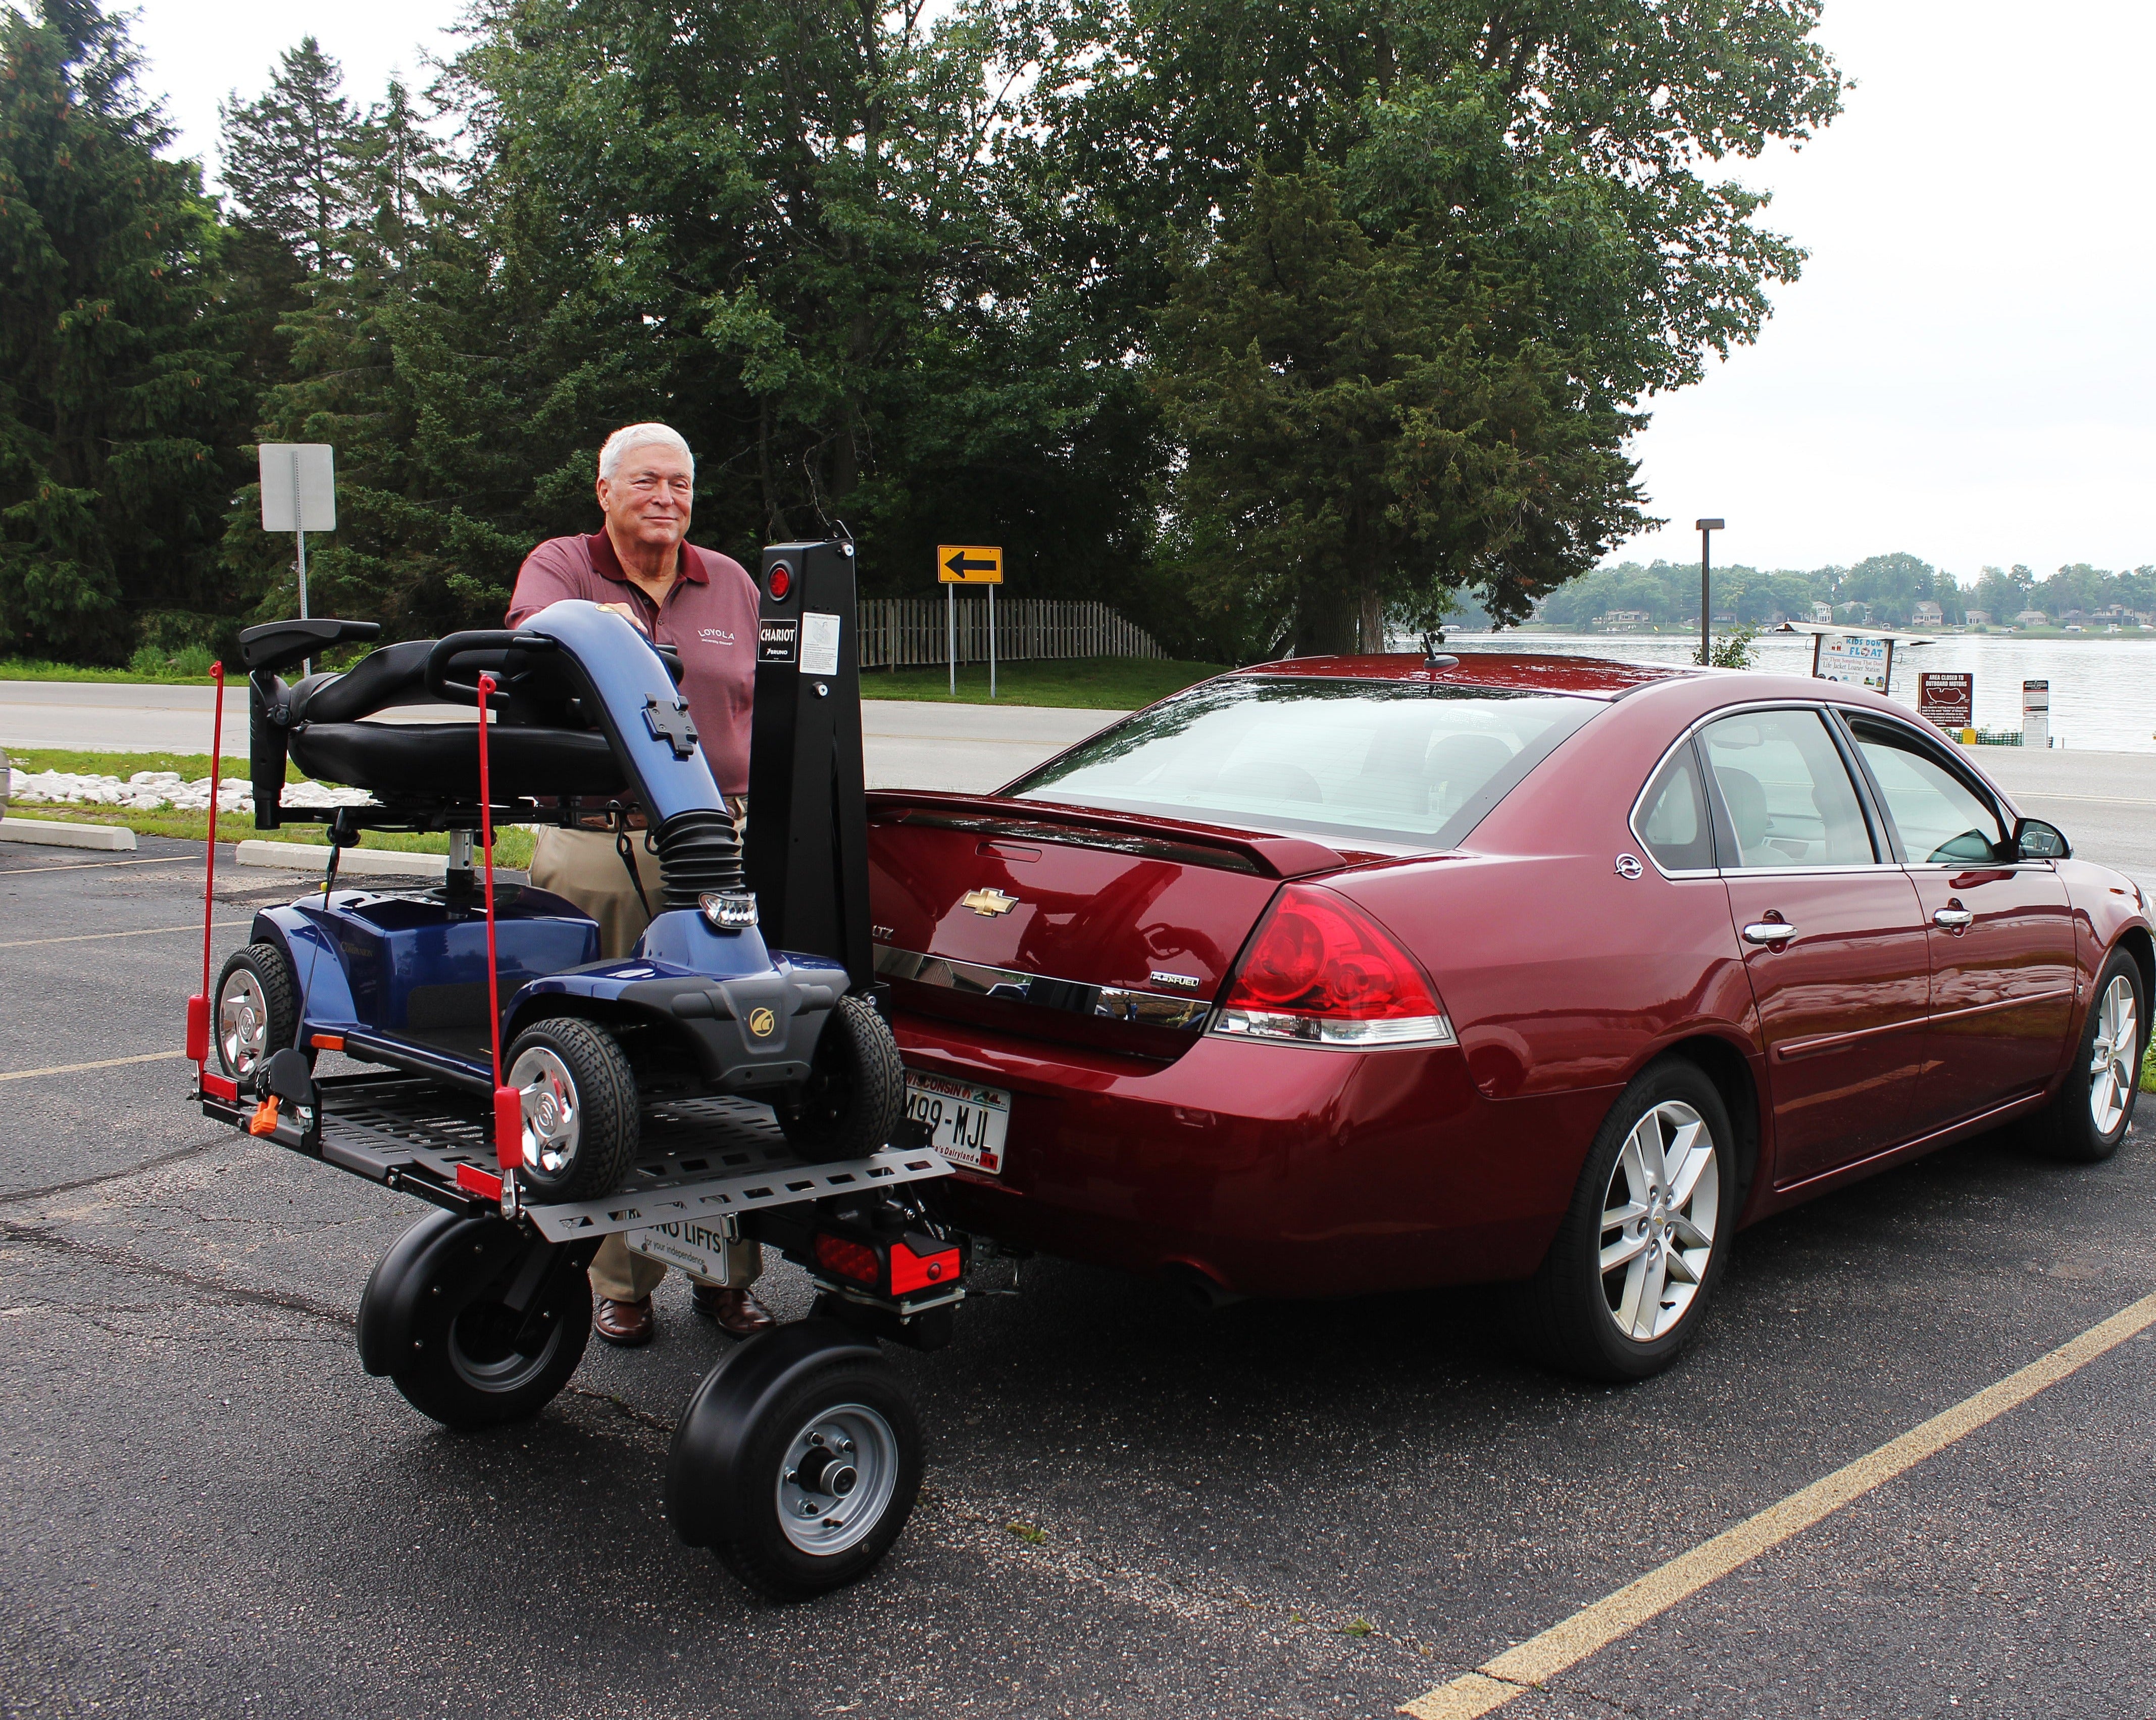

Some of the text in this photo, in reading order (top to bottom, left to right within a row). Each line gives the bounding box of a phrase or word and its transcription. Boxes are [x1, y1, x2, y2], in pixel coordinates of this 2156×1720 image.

[697, 628, 734, 640] LOYOLA
[761, 628, 795, 642] CHARIOT
[1866, 639, 1889, 648] DON'T
[1848, 663, 1863, 671] Loaner
[872, 925, 893, 940] LTZ
[1152, 973, 1196, 987] FLEXFUEL
[907, 1072, 962, 1097] WISCONSIN
[944, 1147, 975, 1162] Dairyland
[684, 1222, 721, 1254] LIFTS
[653, 1241, 665, 1251] your
[666, 1243, 705, 1265] independence
